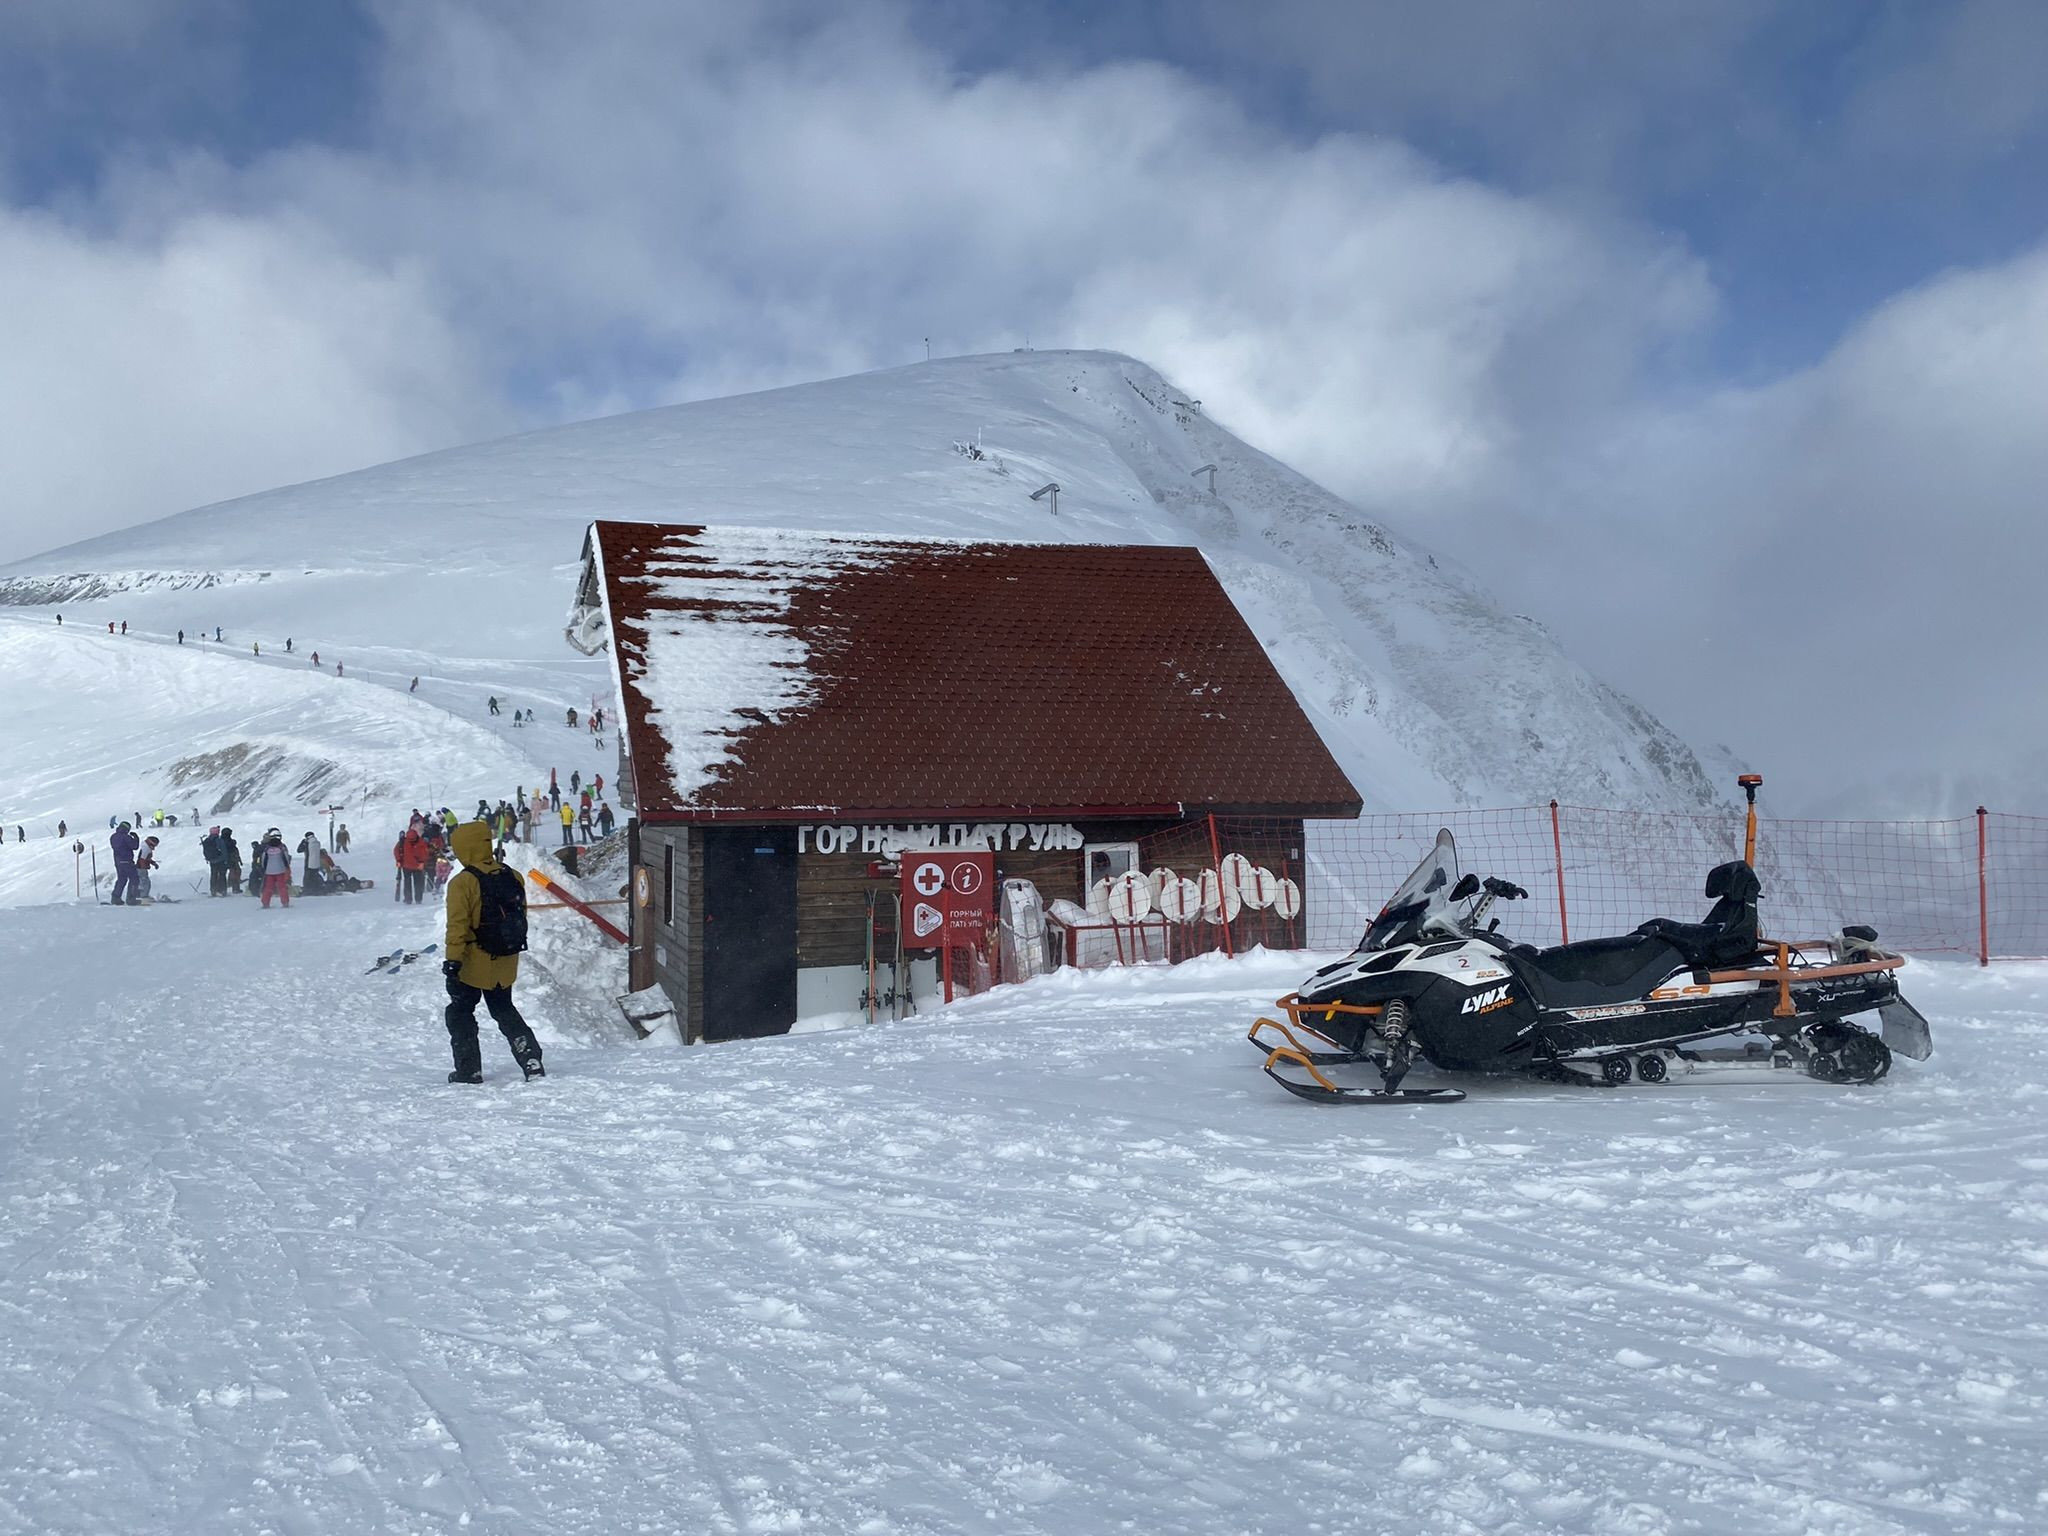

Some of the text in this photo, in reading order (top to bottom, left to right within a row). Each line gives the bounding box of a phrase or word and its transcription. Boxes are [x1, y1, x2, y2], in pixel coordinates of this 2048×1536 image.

[948, 823, 1085, 851] ПАТРУЛЬ
[950, 908, 982, 918] ГОРНЫЙ
[1458, 958, 1470, 968] 2
[1461, 983, 1511, 1014] LYNX
[1480, 997, 1514, 1014] ALPINE
